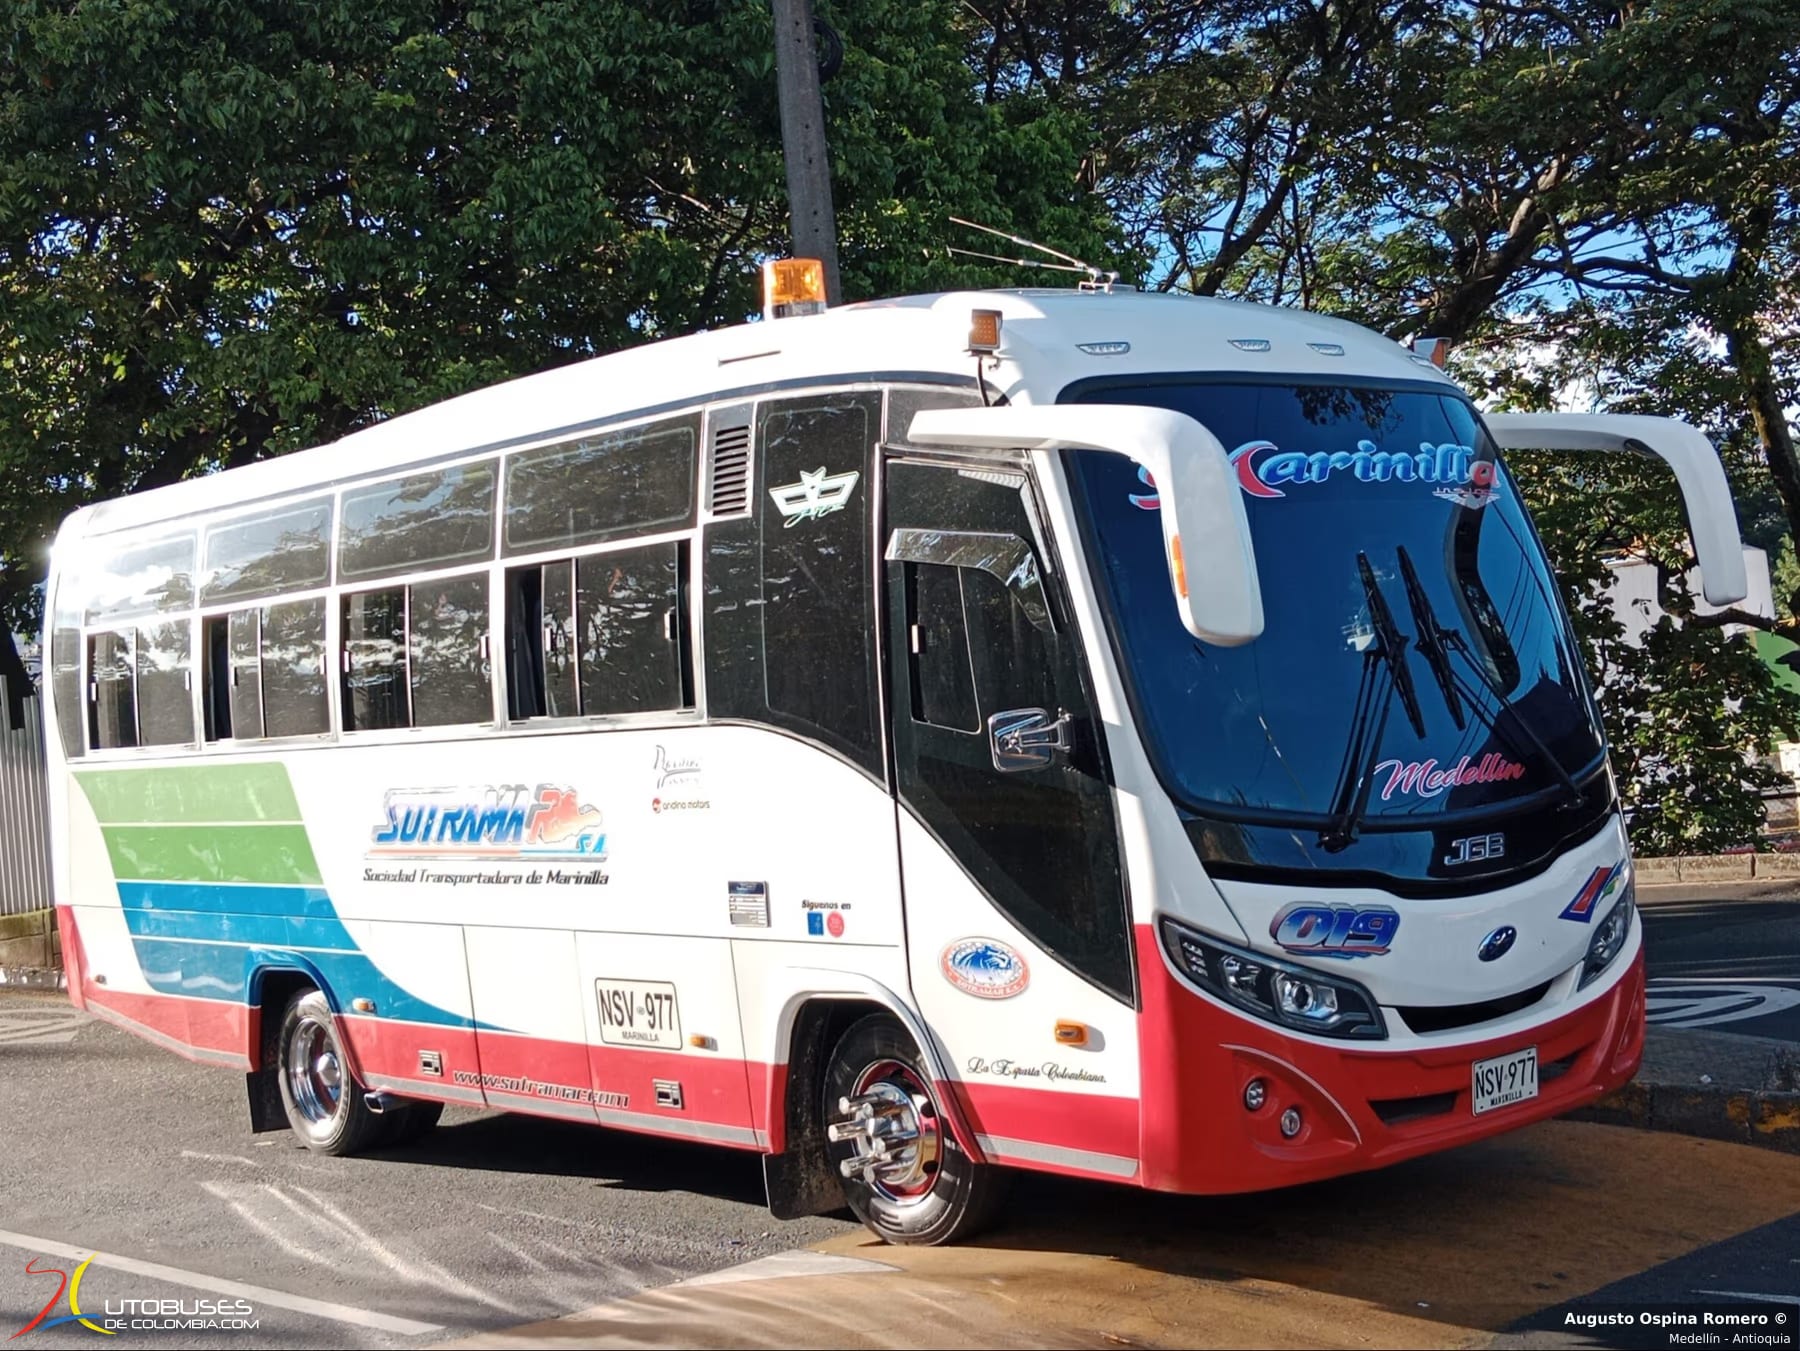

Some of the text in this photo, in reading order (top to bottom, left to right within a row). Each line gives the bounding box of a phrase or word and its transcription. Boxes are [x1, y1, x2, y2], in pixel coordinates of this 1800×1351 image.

[1444, 832, 1505, 866] JGB
[362, 868, 609, 887] Sociedad Transportadora de Marinilla
[841, 902, 852, 910] en
[1270, 902, 1400, 958] 019
[621, 1031, 660, 1042] MARINILLA
[967, 1056, 989, 1074] La
[1490, 1090, 1522, 1106] MARINILLA
